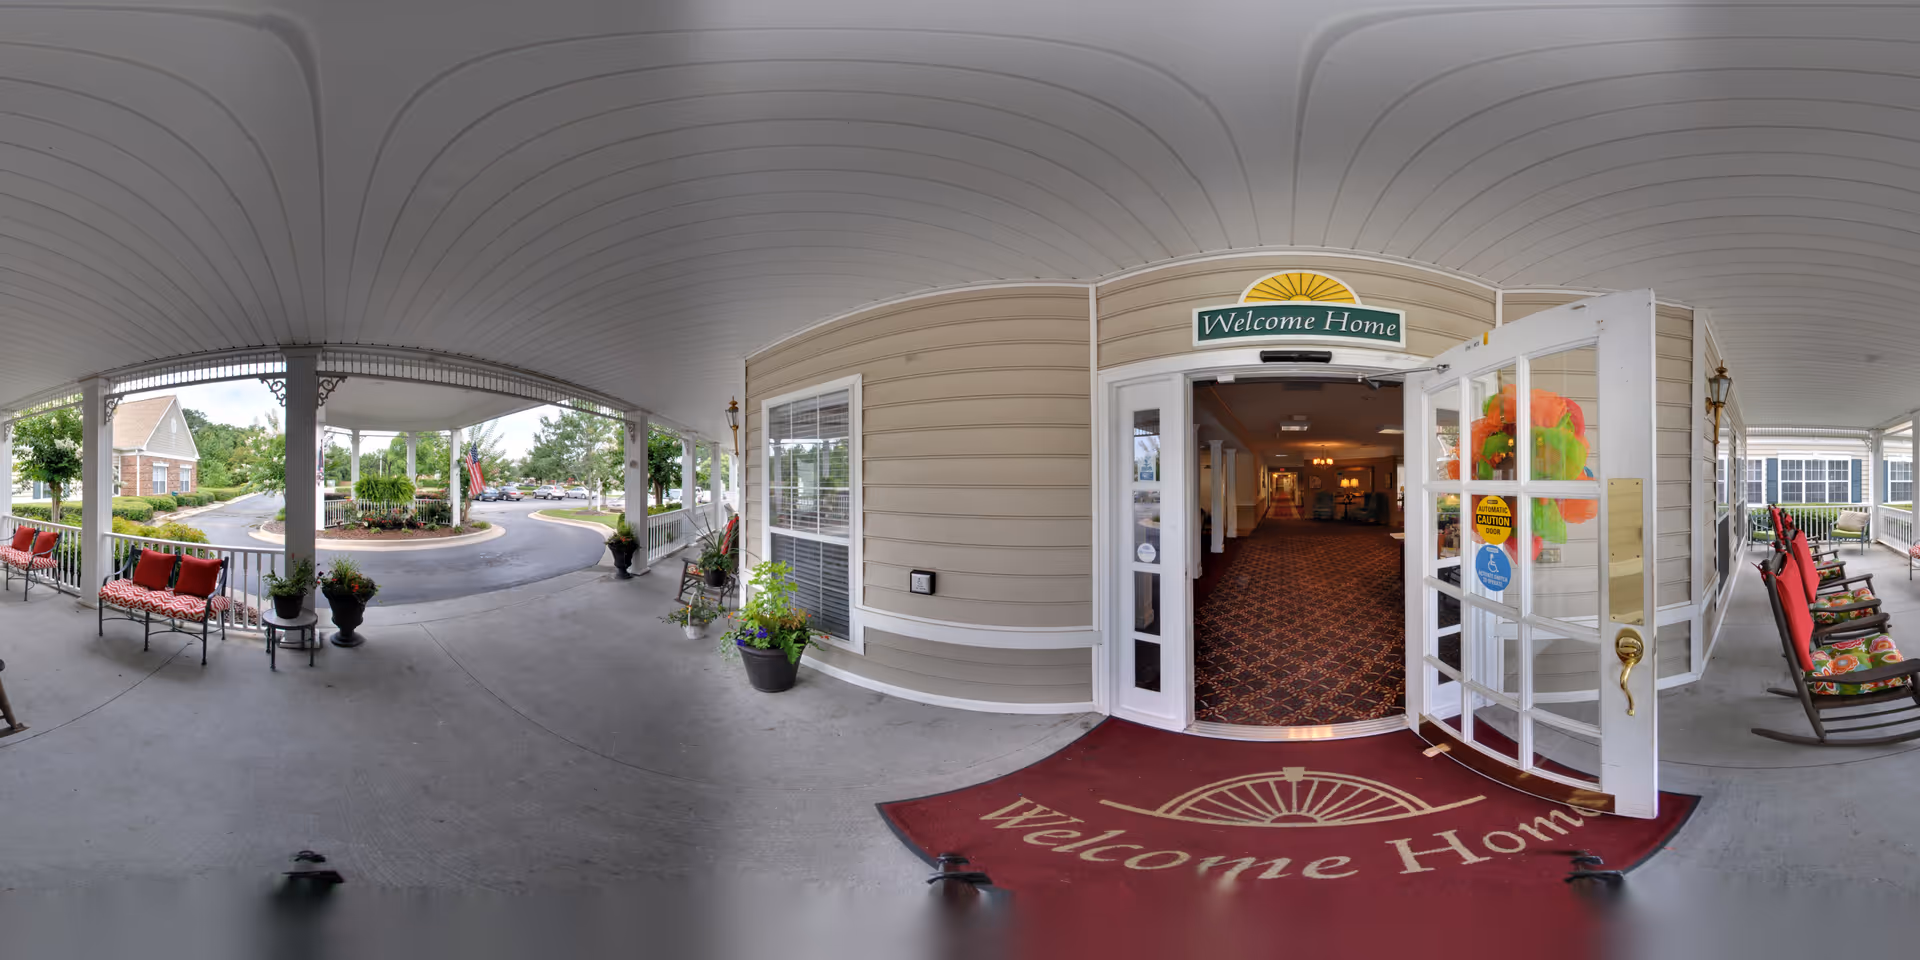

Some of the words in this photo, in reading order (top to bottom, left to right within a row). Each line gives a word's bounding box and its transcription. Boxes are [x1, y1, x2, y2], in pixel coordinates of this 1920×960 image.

[1202, 310, 1316, 335] Welcome
[1323, 310, 1397, 336] Home
[1478, 506, 1508, 514] AUTOMATIC
[1478, 515, 1510, 526] CAUTION
[1486, 528, 1500, 536] DOOR
[979, 796, 1360, 885] Welcome
